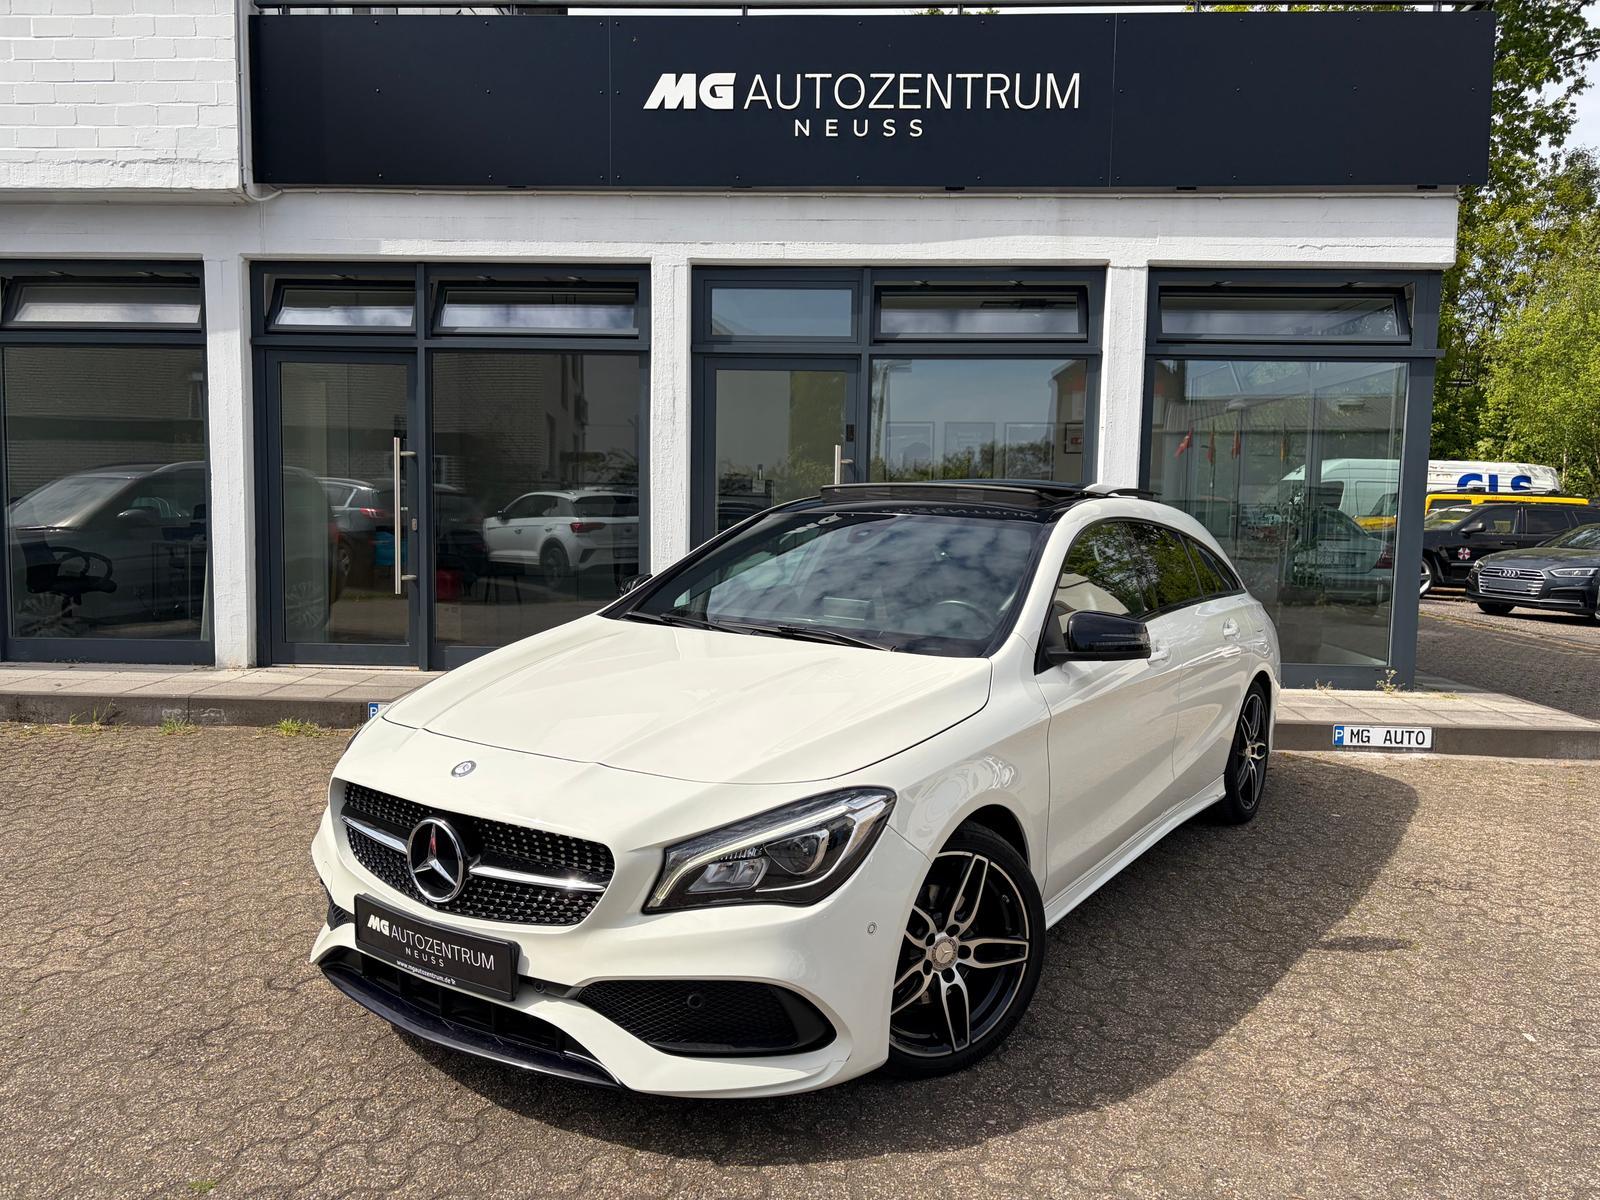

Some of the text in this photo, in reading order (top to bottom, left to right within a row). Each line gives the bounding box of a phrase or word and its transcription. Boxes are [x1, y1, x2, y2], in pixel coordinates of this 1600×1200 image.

[643, 72, 1081, 110] MG AUTOZENTRUM
[794, 118, 923, 137] NEUSS
[1335, 729, 1426, 745] P MG AUTO
[367, 914, 495, 971] MG AUTOZENTRUM
[405, 947, 445, 967] NEUSS
